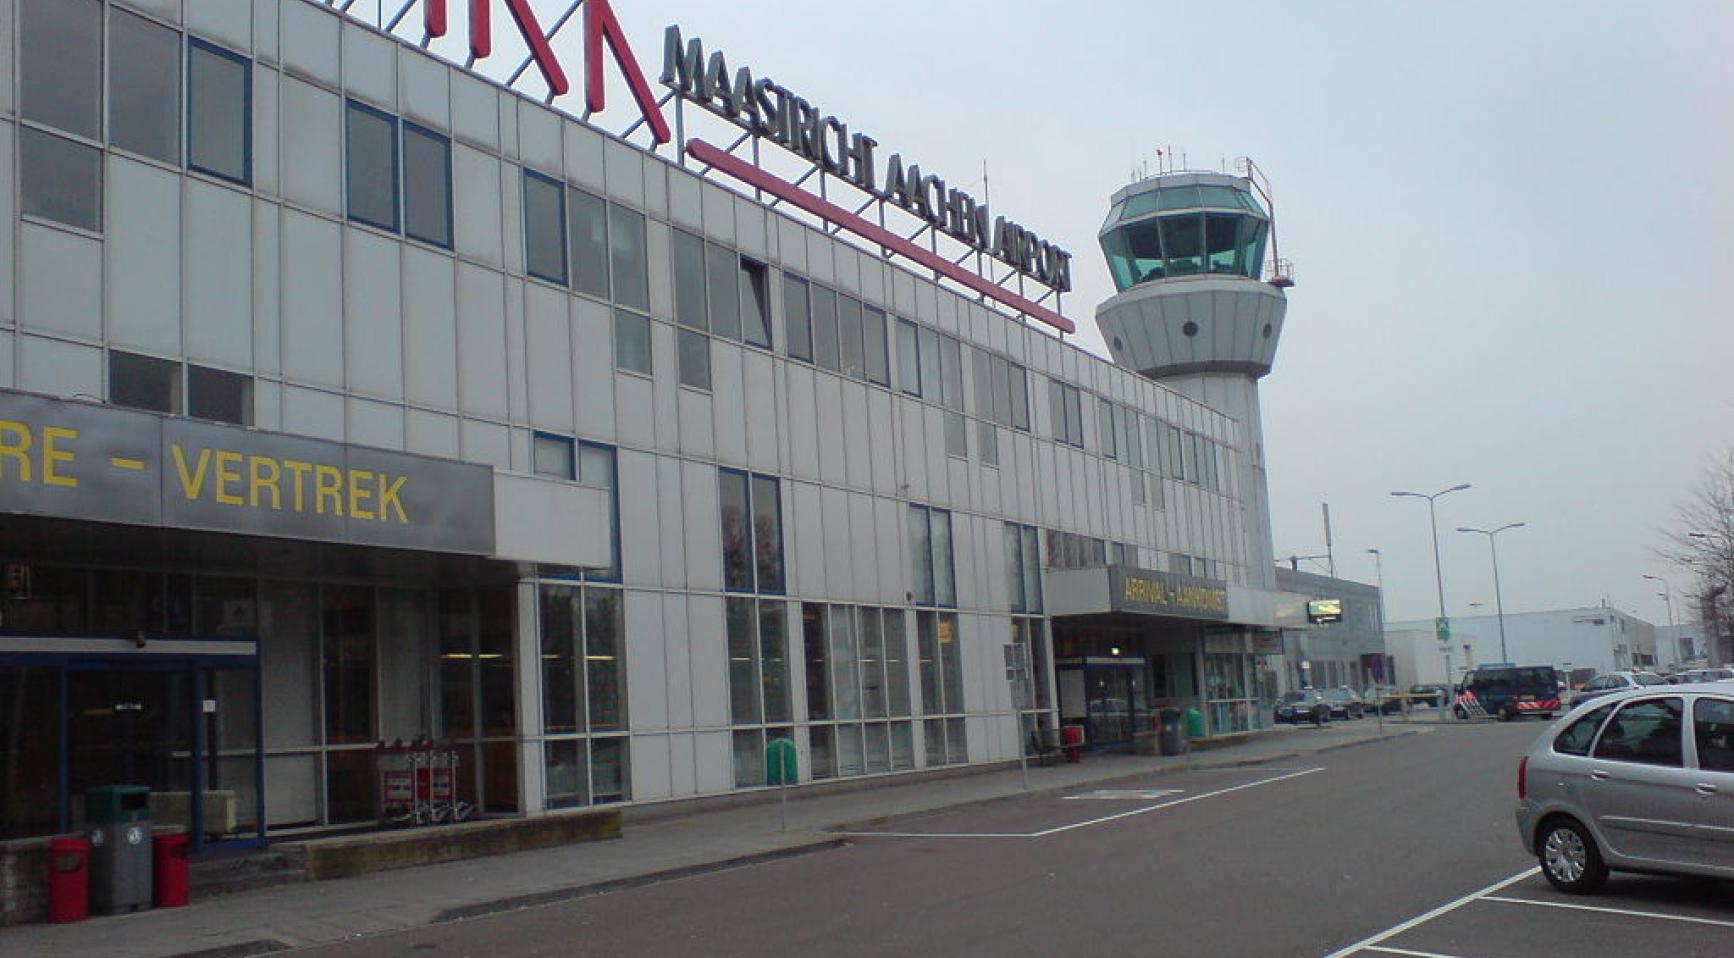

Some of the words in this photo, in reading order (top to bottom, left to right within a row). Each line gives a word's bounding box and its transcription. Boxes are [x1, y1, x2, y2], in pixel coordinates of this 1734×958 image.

[659, 24, 878, 191] MAASTRICHT
[884, 153, 990, 250] AACHEN
[993, 215, 1073, 293] AIRPORT
[170, 443, 409, 524] VERTREK
[1124, 576, 1168, 606] ARRIVAL
